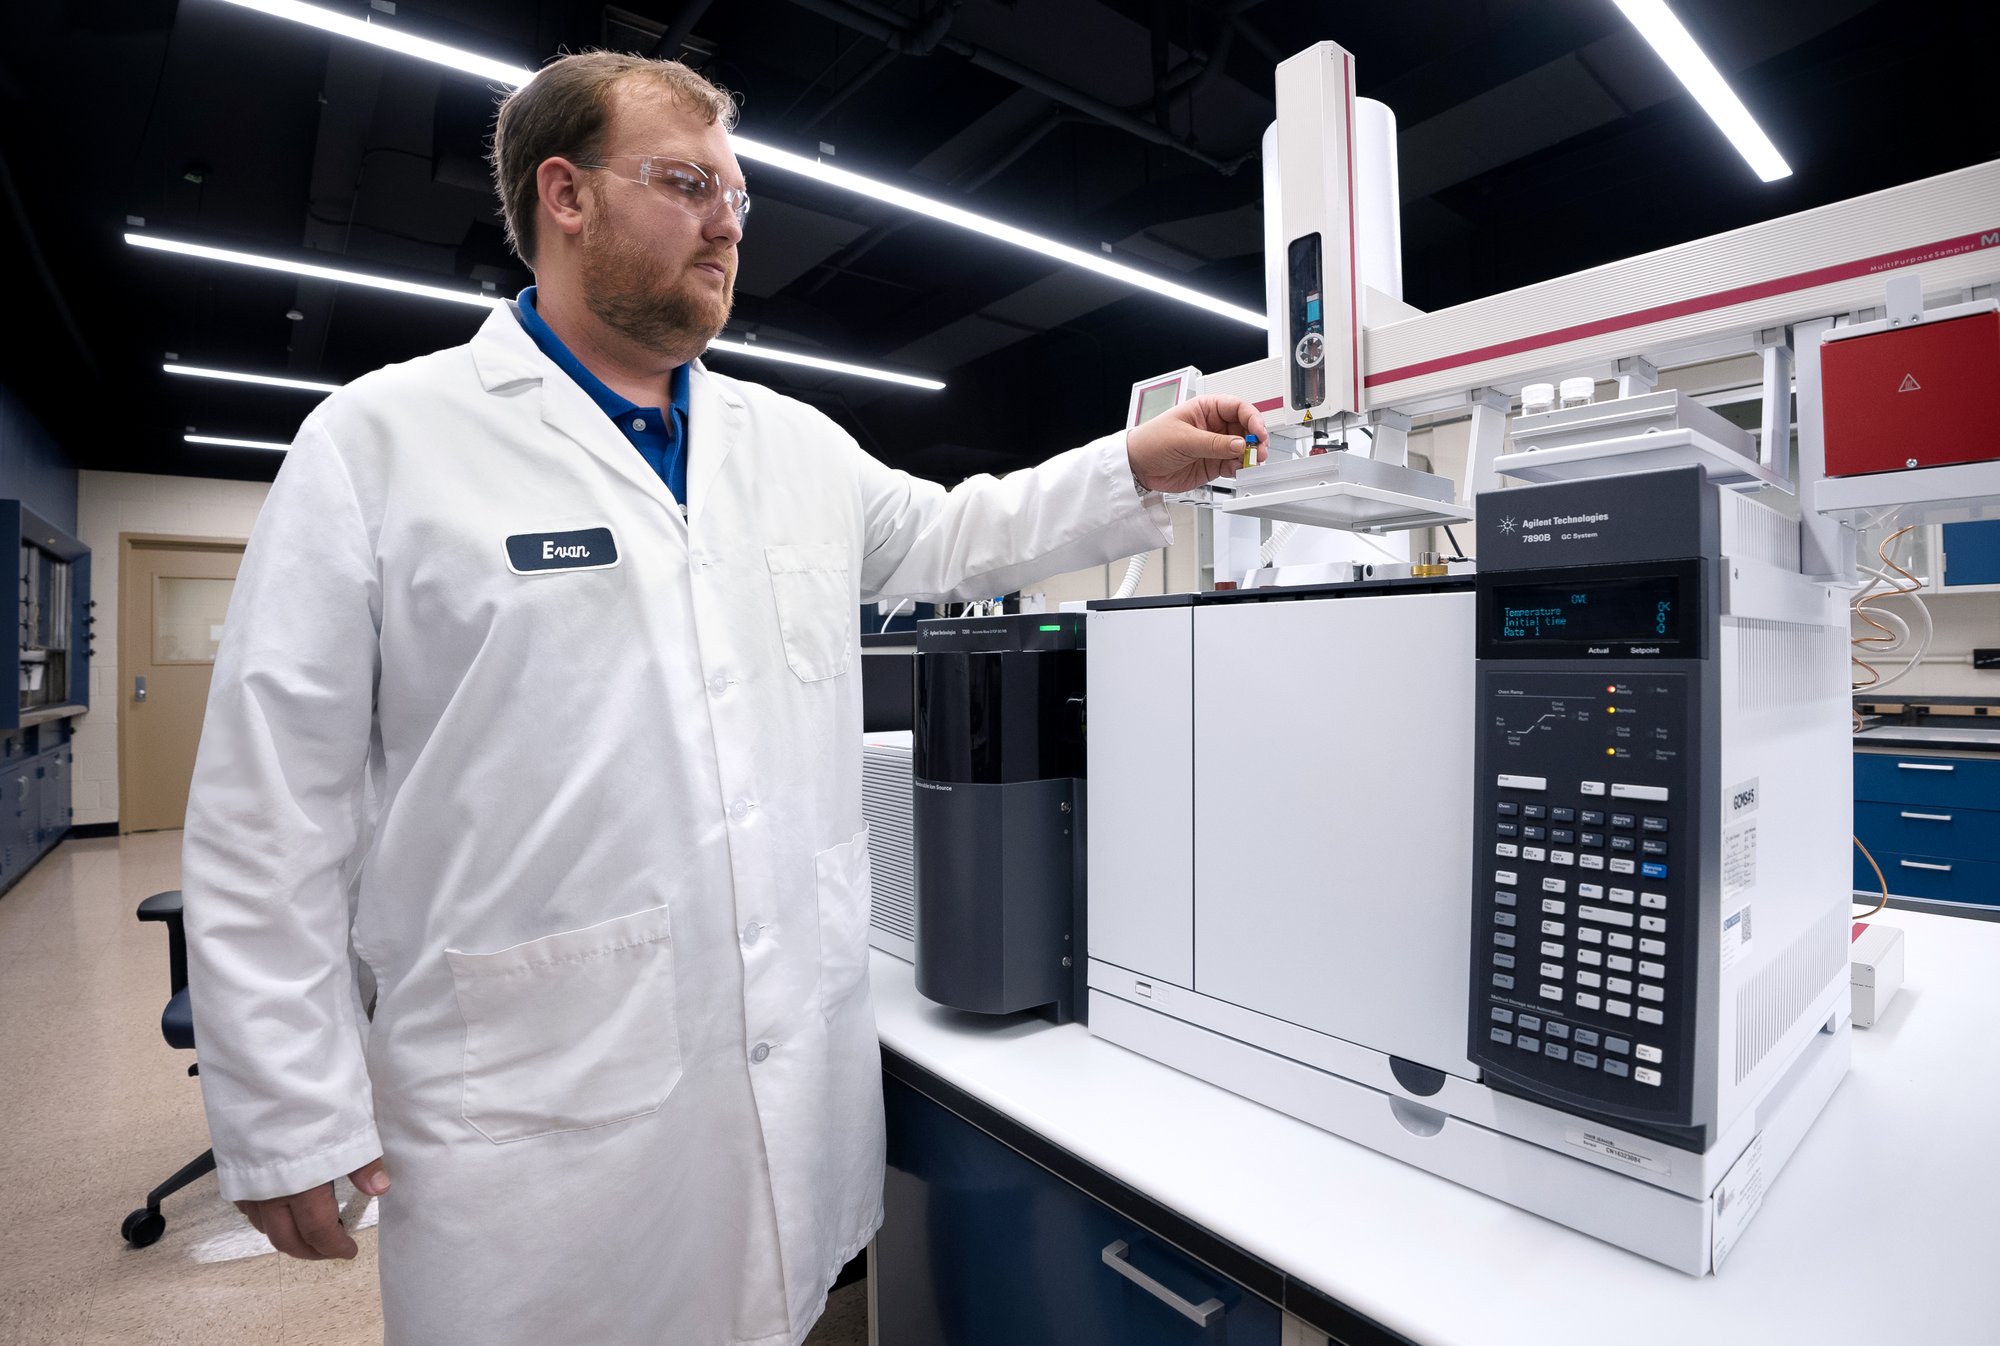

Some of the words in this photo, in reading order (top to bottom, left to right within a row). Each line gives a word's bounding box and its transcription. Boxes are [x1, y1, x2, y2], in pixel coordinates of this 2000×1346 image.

[1870, 244, 1975, 271] MultiPurposeSampler
[1522, 518, 1552, 529] Agilent
[1553, 513, 1609, 524] Technologies
[1522, 533, 1551, 543] 7890B
[542, 540, 590, 559] Evan
[1504, 607, 1561, 617] Temperature
[1505, 616, 1539, 626] Initial
[1545, 616, 1567, 626] time
[1504, 627, 1525, 636] Rate
